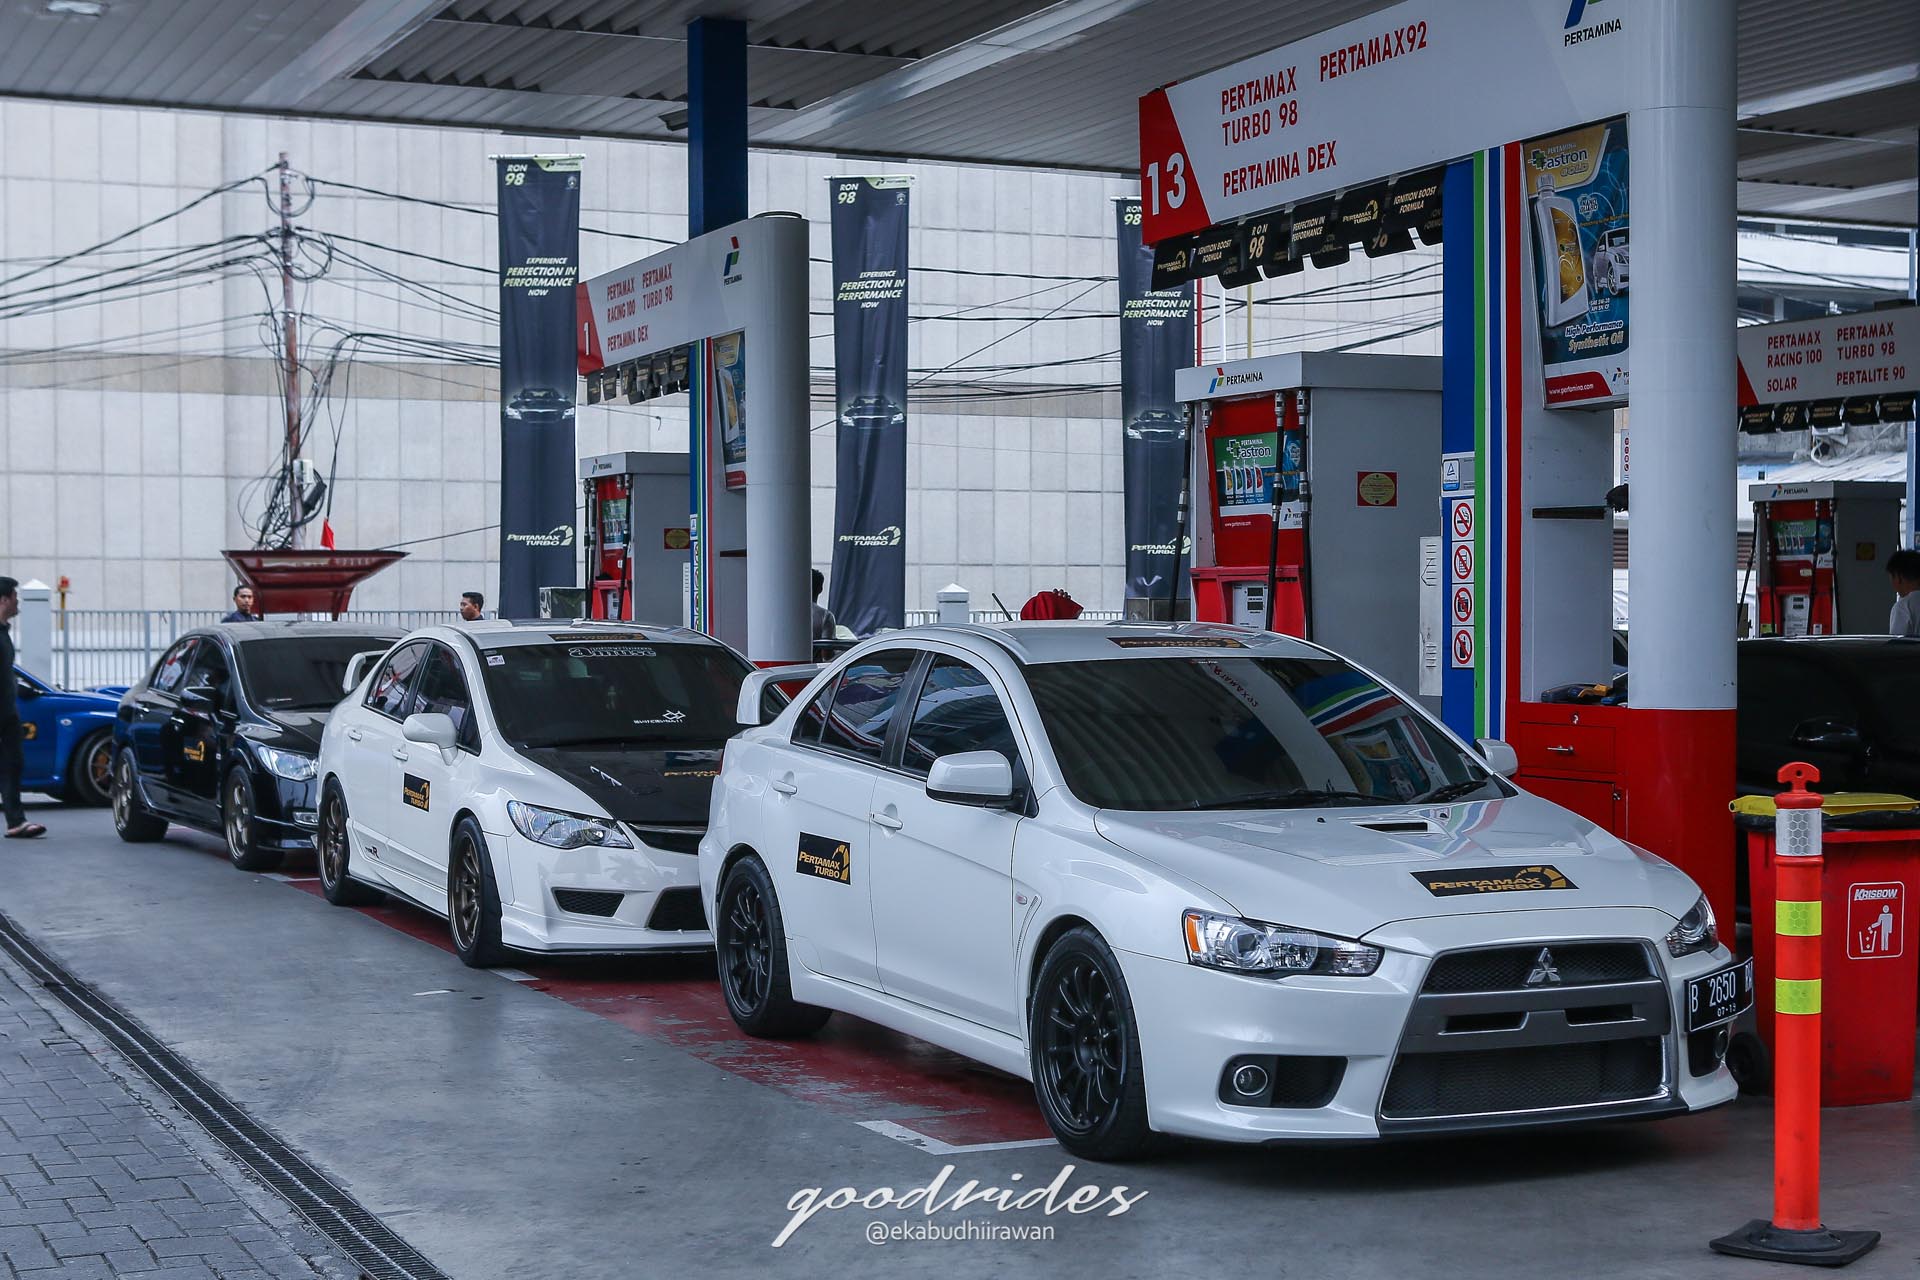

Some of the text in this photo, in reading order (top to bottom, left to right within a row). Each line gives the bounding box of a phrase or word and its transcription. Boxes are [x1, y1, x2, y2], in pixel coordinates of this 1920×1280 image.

[1564, 18, 1622, 48] PERTAMINA
[1221, 66, 1297, 115] PERTAMAX
[1222, 100, 1298, 146] TURBO 98
[506, 164, 528, 172] RON
[1223, 140, 1337, 197] PERTAMINA DEX
[504, 172, 525, 186] 98
[1146, 152, 1186, 216] 13
[840, 183, 859, 191] RON
[838, 192, 856, 204] 98
[1394, 185, 1437, 205] IGNITION BOOST
[1399, 200, 1424, 214] FORMULA
[1124, 214, 1142, 225] 98
[1343, 210, 1372, 222] PERTAMAX
[1354, 215, 1372, 224] TURBO
[1252, 224, 1268, 236] RON
[1292, 218, 1321, 232] PERFECTION
[1291, 226, 1323, 241] PERFORMANCE
[1249, 236, 1264, 259] 98
[526, 257, 568, 265] EXPERIENCE
[506, 266, 577, 276] PERFECTION IN
[642, 263, 673, 289] PERTAMAX
[859, 270, 897, 278] EXPERIENCE
[503, 278, 574, 287] PERFORMANCE
[606, 277, 635, 301] PERTAMAX
[840, 279, 905, 290] PERFECTION IN
[643, 286, 673, 311] TURBO 98
[837, 289, 903, 301] PERFORMANCE
[860, 301, 880, 309] NOW
[1125, 299, 1192, 308] PERFECTION IN
[607, 299, 636, 323] RACING 100
[1122, 309, 1189, 318] PERFORMANCE
[1565, 319, 1624, 338] High Performance
[1837, 322, 1894, 341] PERTAMAX
[607, 325, 649, 352] PERTAMINA DEX
[1568, 330, 1624, 354] Synthetic Oil
[1768, 330, 1821, 349] PERTAMAX
[1837, 341, 1895, 360] TURBO 98
[1767, 349, 1822, 368] RACING 100
[1227, 372, 1263, 385] PERTAMINA
[1836, 366, 1905, 385] PERTALITE 90
[1767, 377, 1797, 392] SOLAR
[1782, 412, 1795, 424] 98
[798, 851, 841, 870] PERTAMAX
[814, 865, 841, 879] TURBO
[1429, 877, 1542, 890] PERTAMAX
[1474, 882, 1545, 892] TURBO
[1854, 888, 1898, 900] KRISBOW
[1691, 984, 1699, 1013] B
[1709, 971, 1736, 1008] 2650
